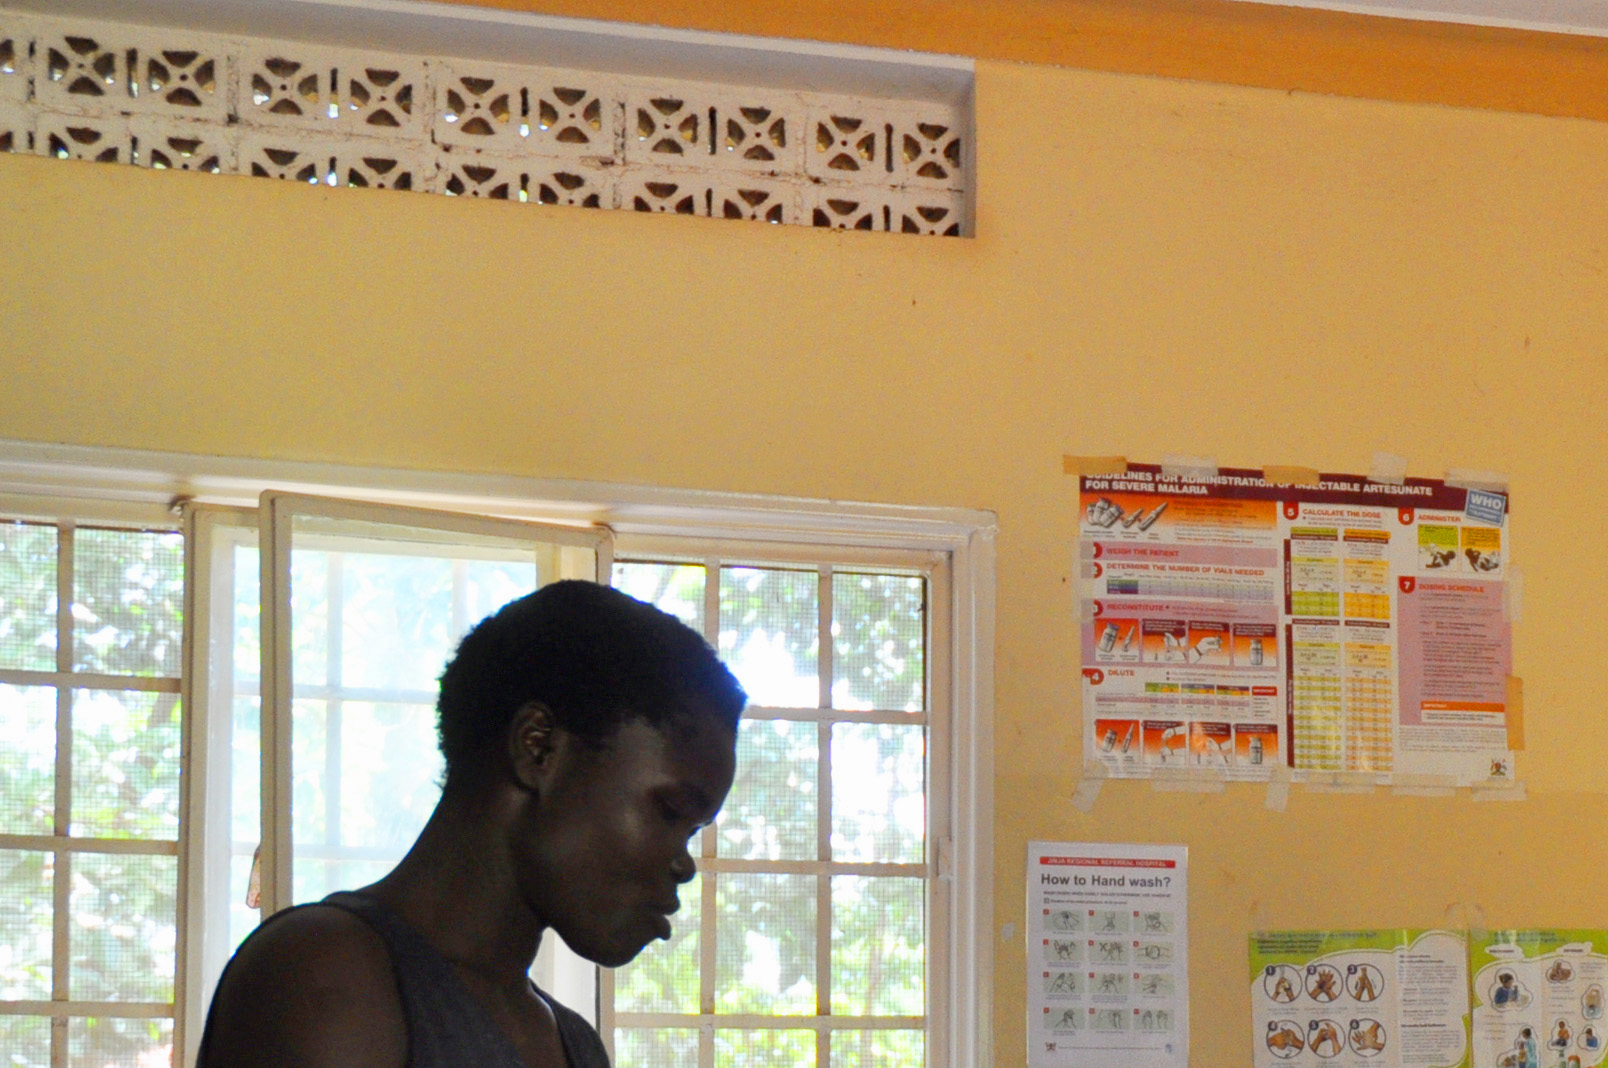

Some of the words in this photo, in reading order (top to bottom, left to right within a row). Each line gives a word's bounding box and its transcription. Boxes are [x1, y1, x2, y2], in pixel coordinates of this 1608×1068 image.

[1085, 480, 1110, 490] FOR
[1111, 481, 1156, 492] SEVERE
[1157, 483, 1208, 495] MALARIA
[1363, 483, 1434, 496] ARTESUNATE
[1470, 493, 1501, 509] WHO
[1302, 508, 1345, 517] CALCULATE
[1346, 510, 1360, 518] THE
[1402, 513, 1410, 522] 6
[1418, 514, 1462, 523] ADMINISTER
[1133, 549, 1148, 557] THE
[1149, 550, 1180, 558] PATIENT
[1107, 562, 1151, 571] DETERMINE
[1152, 564, 1167, 572] THE
[1168, 565, 1201, 573] NUMBER
[1202, 566, 1212, 574] OF
[1213, 567, 1234, 576] VIALS
[1234, 568, 1265, 577] NEEDED
[1403, 581, 1412, 590] 7
[1107, 603, 1165, 612] RECONSTITUTE
[1107, 669, 1135, 677] DILUTE
[1041, 873, 1071, 886] How
[1073, 874, 1087, 886] to
[1091, 874, 1126, 887] Hand
[1129, 876, 1172, 888] wash?
